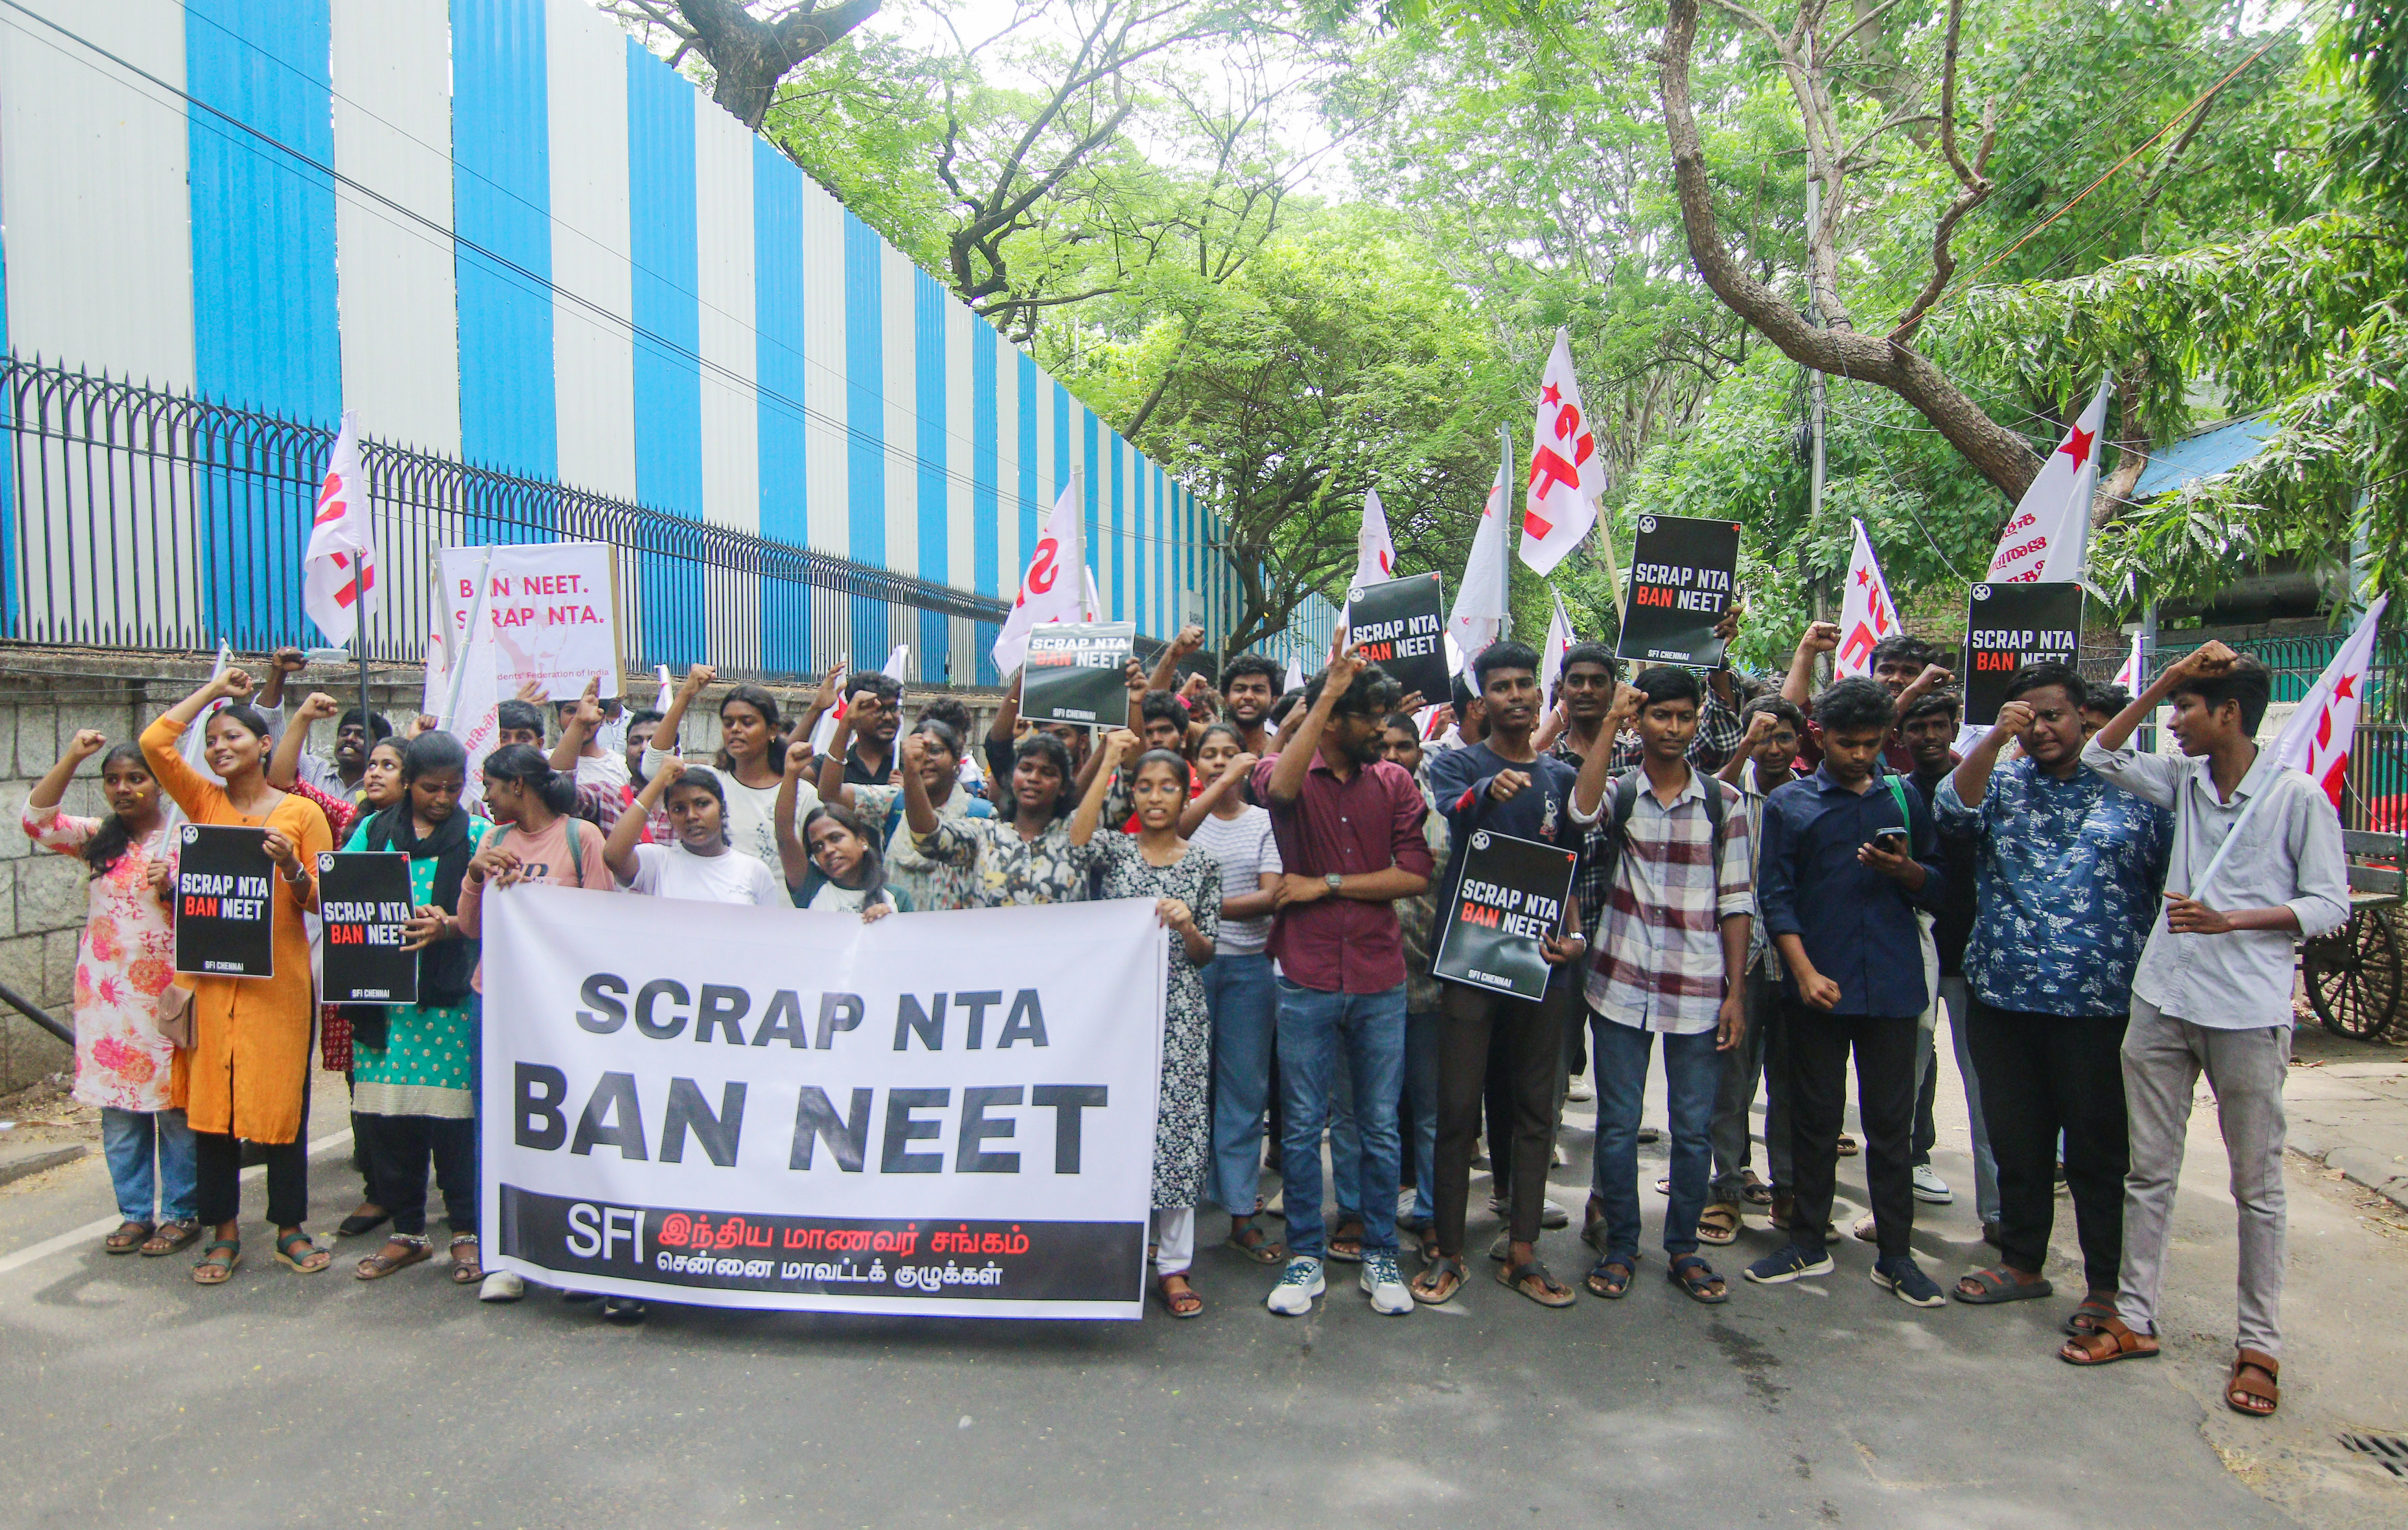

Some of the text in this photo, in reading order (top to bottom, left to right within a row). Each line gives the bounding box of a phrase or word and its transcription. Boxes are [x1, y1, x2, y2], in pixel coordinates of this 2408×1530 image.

[460, 574, 589, 598] BN NEET.
[1635, 563, 1730, 591] SCRAP NTA
[1637, 586, 1723, 613] BAN NEET
[456, 605, 605, 629] SRAP NTA.
[1353, 614, 1440, 644] SCRAP NTA
[1031, 637, 1128, 651] SCRAP NTA
[1395, 634, 1436, 658] NEET
[1973, 630, 2075, 650] SCRAP NTA
[1036, 651, 1123, 670] BAN NEET
[1648, 649, 1690, 661] SFI CHENNAI
[1977, 652, 2014, 670] BAN
[527, 670, 574, 679] Federation
[181, 873, 269, 897] SCRAP NTA
[185, 896, 264, 920] BAN NEET
[324, 901, 412, 922] SCRAP NTA
[1462, 878, 1559, 921] SCRAP NTA
[1461, 902, 1551, 941] BAN NEET
[331, 924, 407, 945] BAN NEET
[205, 961, 244, 971] SFI CHENNAI
[1468, 969, 1512, 988] SFI CHENNAI
[352, 989, 390, 998] SFI CHENNAI
[575, 973, 1050, 1051] SCRAP NTA
[515, 1061, 1108, 1175] BAN NEET
[567, 1203, 646, 1264] SFI
[658, 1213, 1030, 1258] இந்திய மாணவர் சங்கம்
[656, 1250, 1003, 1293] சென்னை மாவட்டக் குழுக்கள்
